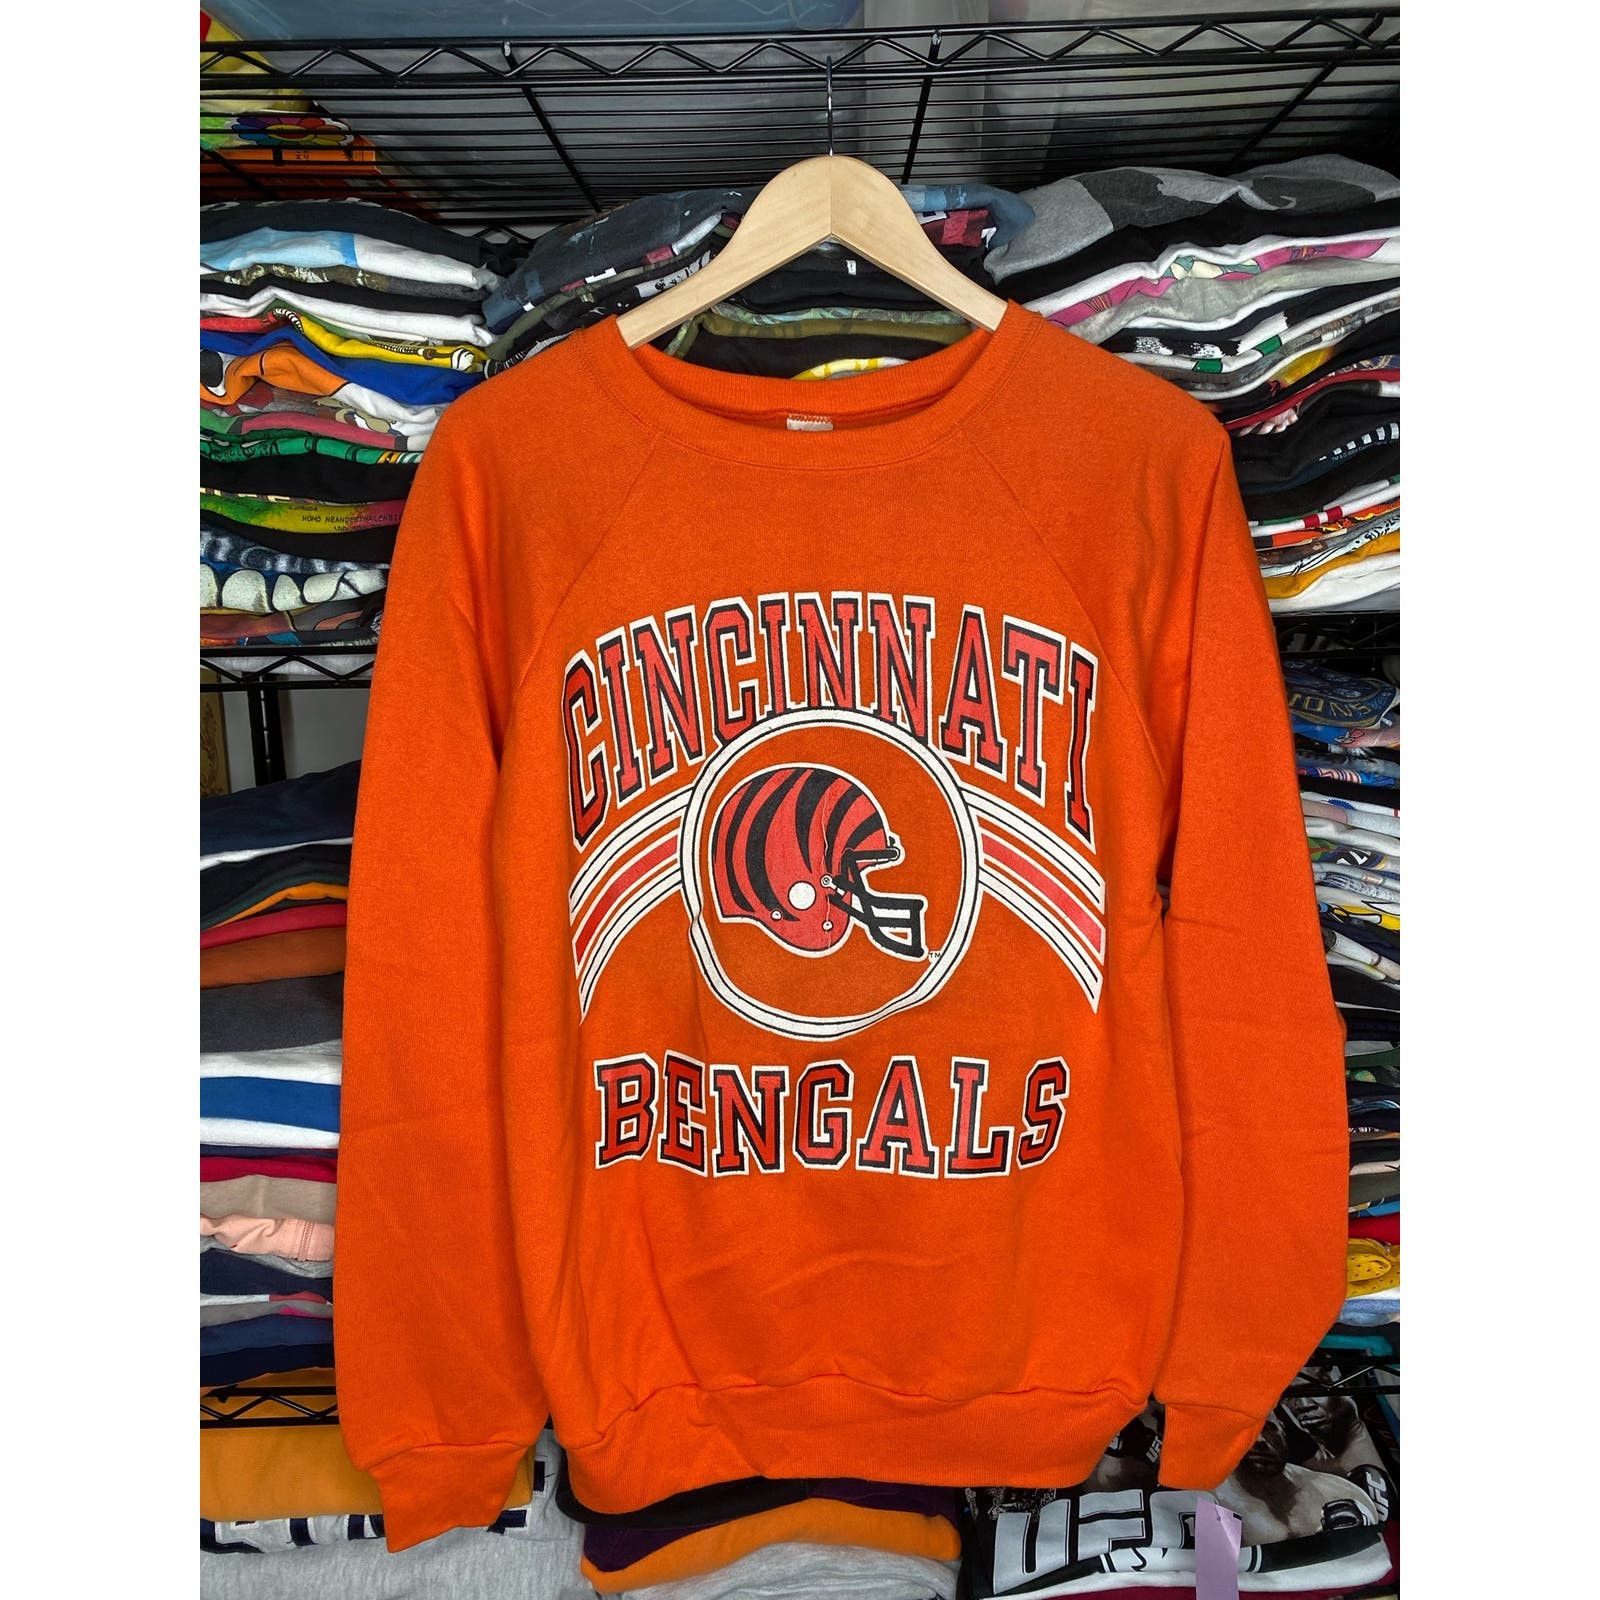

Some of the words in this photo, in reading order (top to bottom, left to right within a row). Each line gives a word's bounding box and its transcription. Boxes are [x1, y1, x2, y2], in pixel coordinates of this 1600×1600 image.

[562, 591, 1098, 854] CINCINNATI
[593, 1048, 1071, 1179] BENGALS
[1365, 1471, 1390, 1523] UFC
